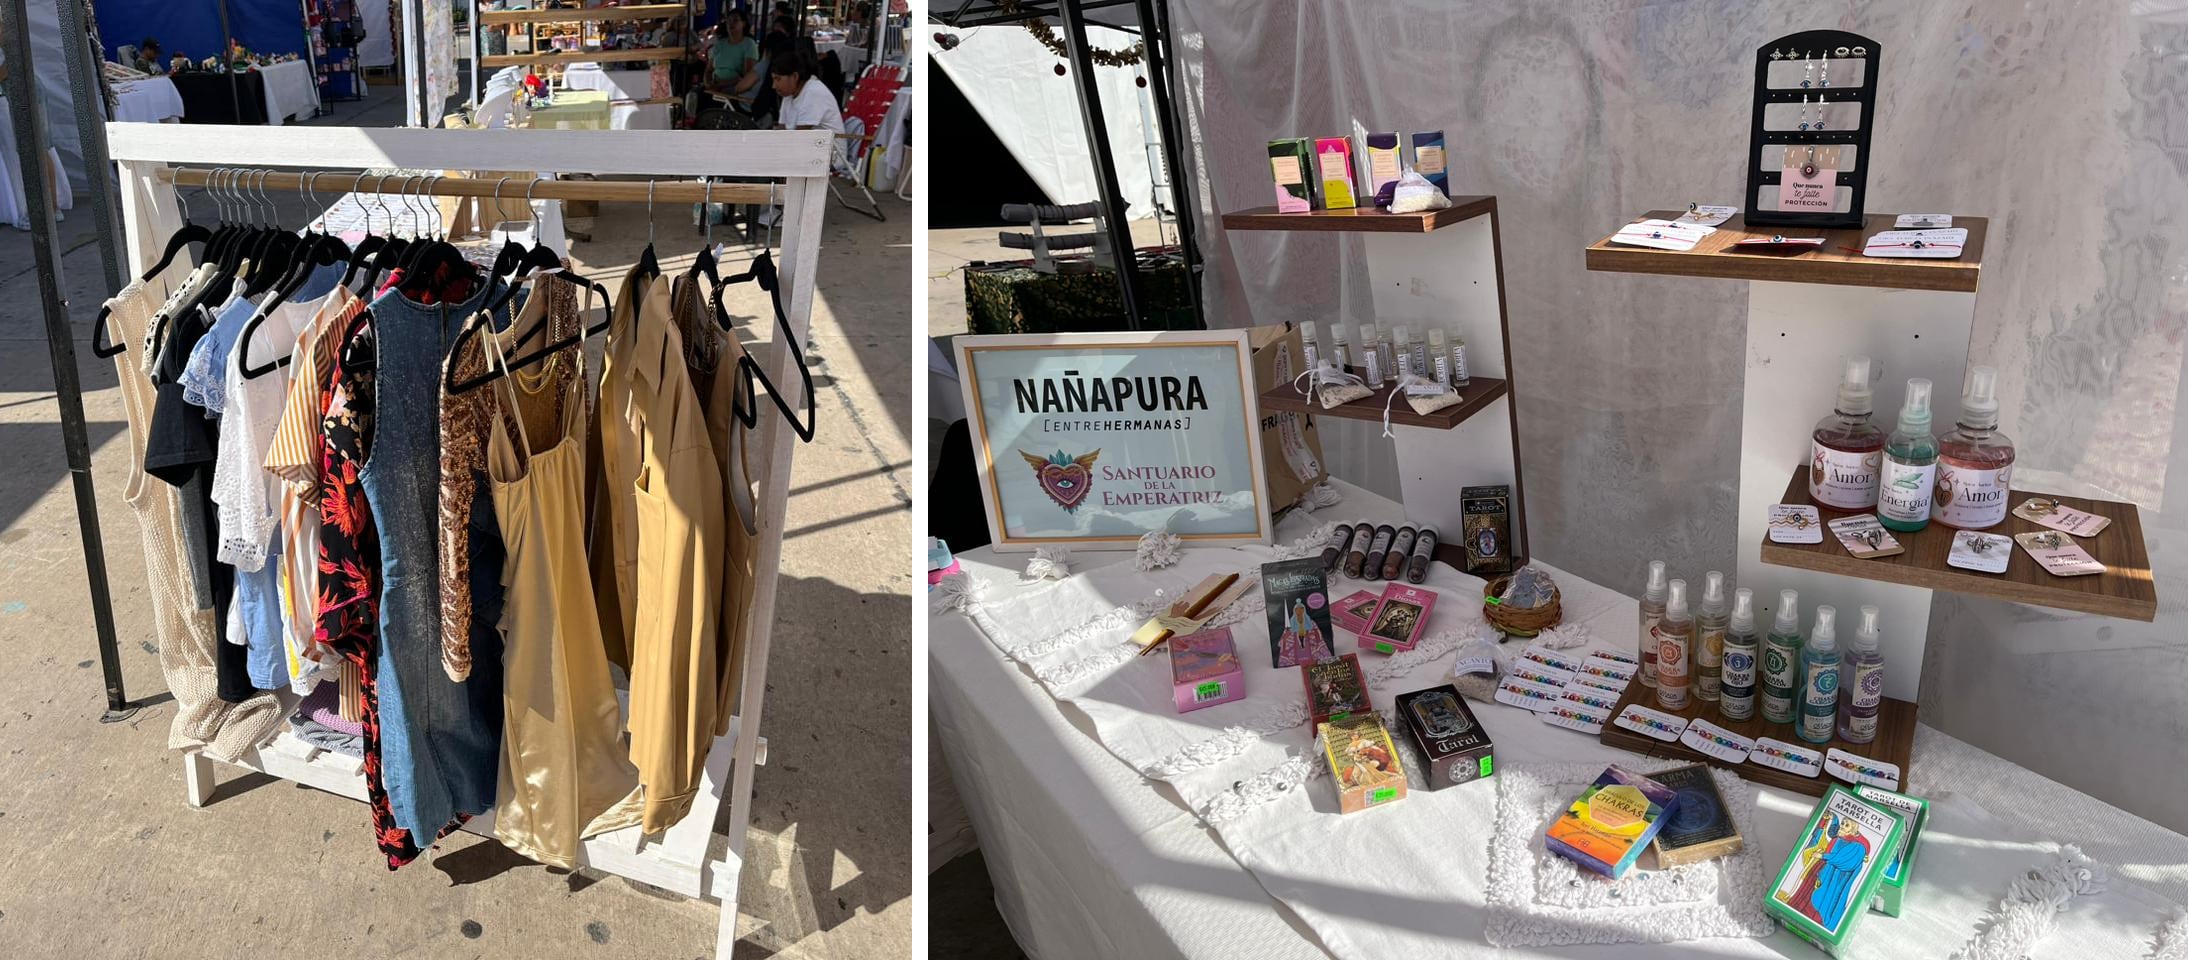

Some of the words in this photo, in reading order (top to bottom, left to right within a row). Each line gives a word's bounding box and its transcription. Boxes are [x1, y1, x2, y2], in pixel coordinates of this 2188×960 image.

[1013, 370, 1208, 413] NAÑAPURA
[1102, 465, 1216, 481] SANTUARIO
[1829, 468, 1873, 484] Amor
[1144, 481, 1160, 490] DE
[1162, 481, 1176, 490] LA
[1102, 490, 1223, 506] EMPERATRIZ
[1879, 489, 1930, 511] Energía
[1959, 487, 2004, 502] Amor
[1865, 793, 1911, 811] MARSELLA
[1869, 790, 1896, 802] TAROT
[1595, 792, 1644, 818] CHAKRAS
[1841, 797, 1869, 816] TAROT
[1870, 813, 1884, 824] DE
[1835, 803, 1881, 831] MARSELLA
